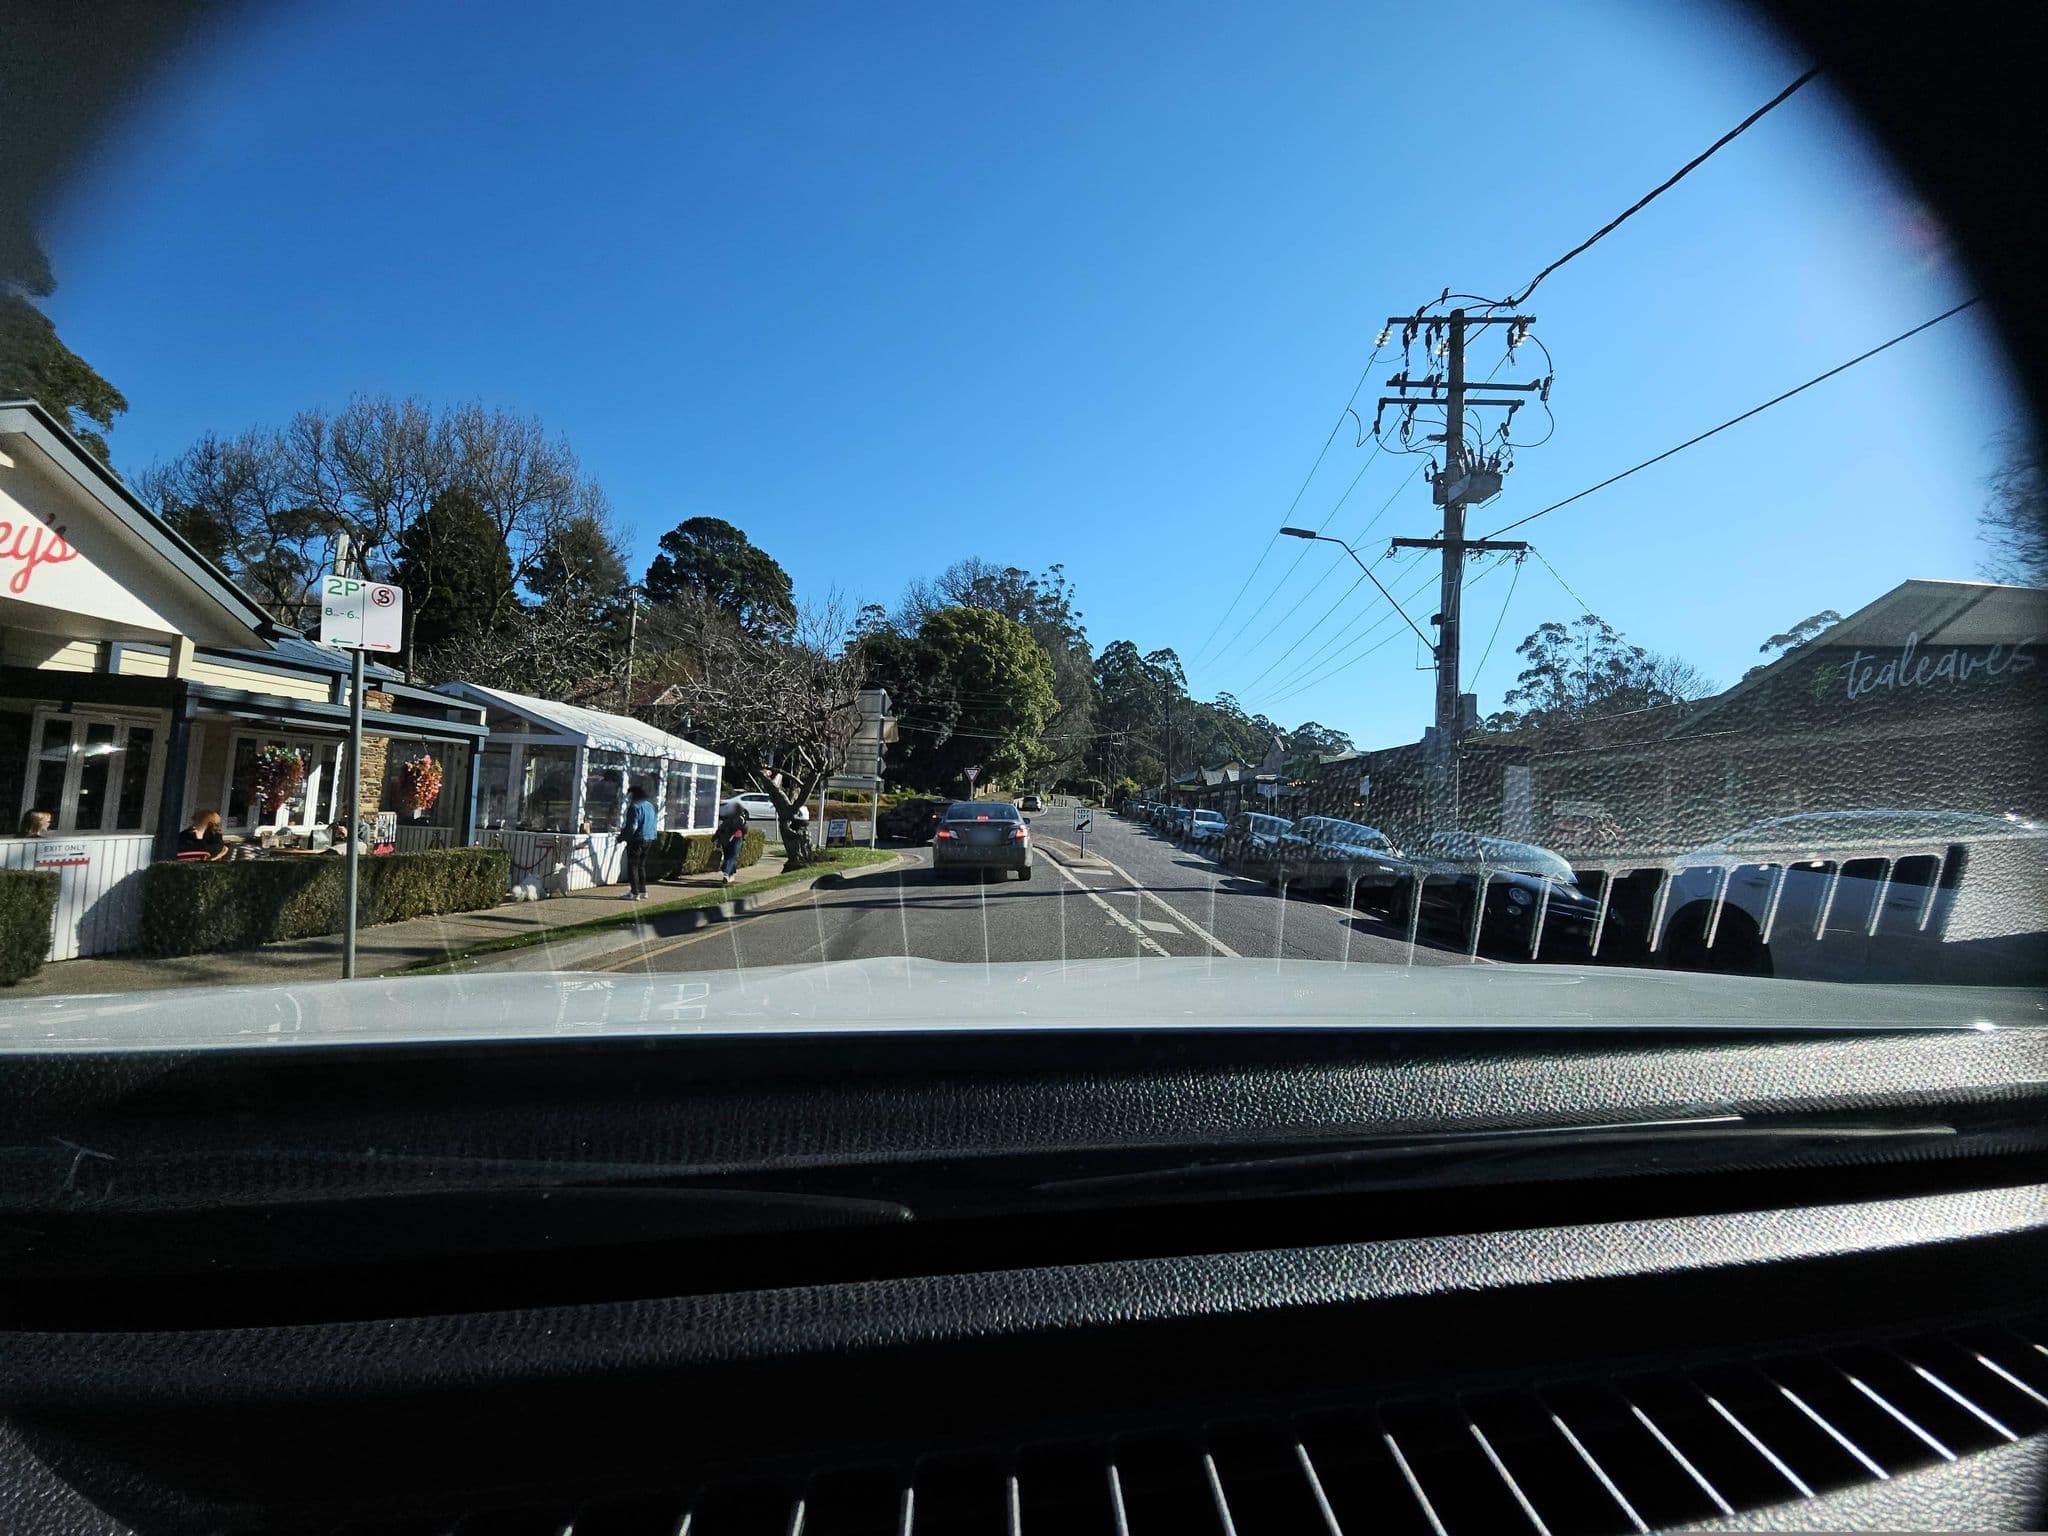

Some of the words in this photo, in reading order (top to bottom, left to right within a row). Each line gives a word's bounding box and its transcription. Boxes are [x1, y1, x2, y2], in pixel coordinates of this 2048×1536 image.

[327, 578, 360, 596] 2P
[1839, 631, 2038, 700] tealeaves
[44, 845, 63, 853] EXIT
[64, 844, 87, 852] ONLY
